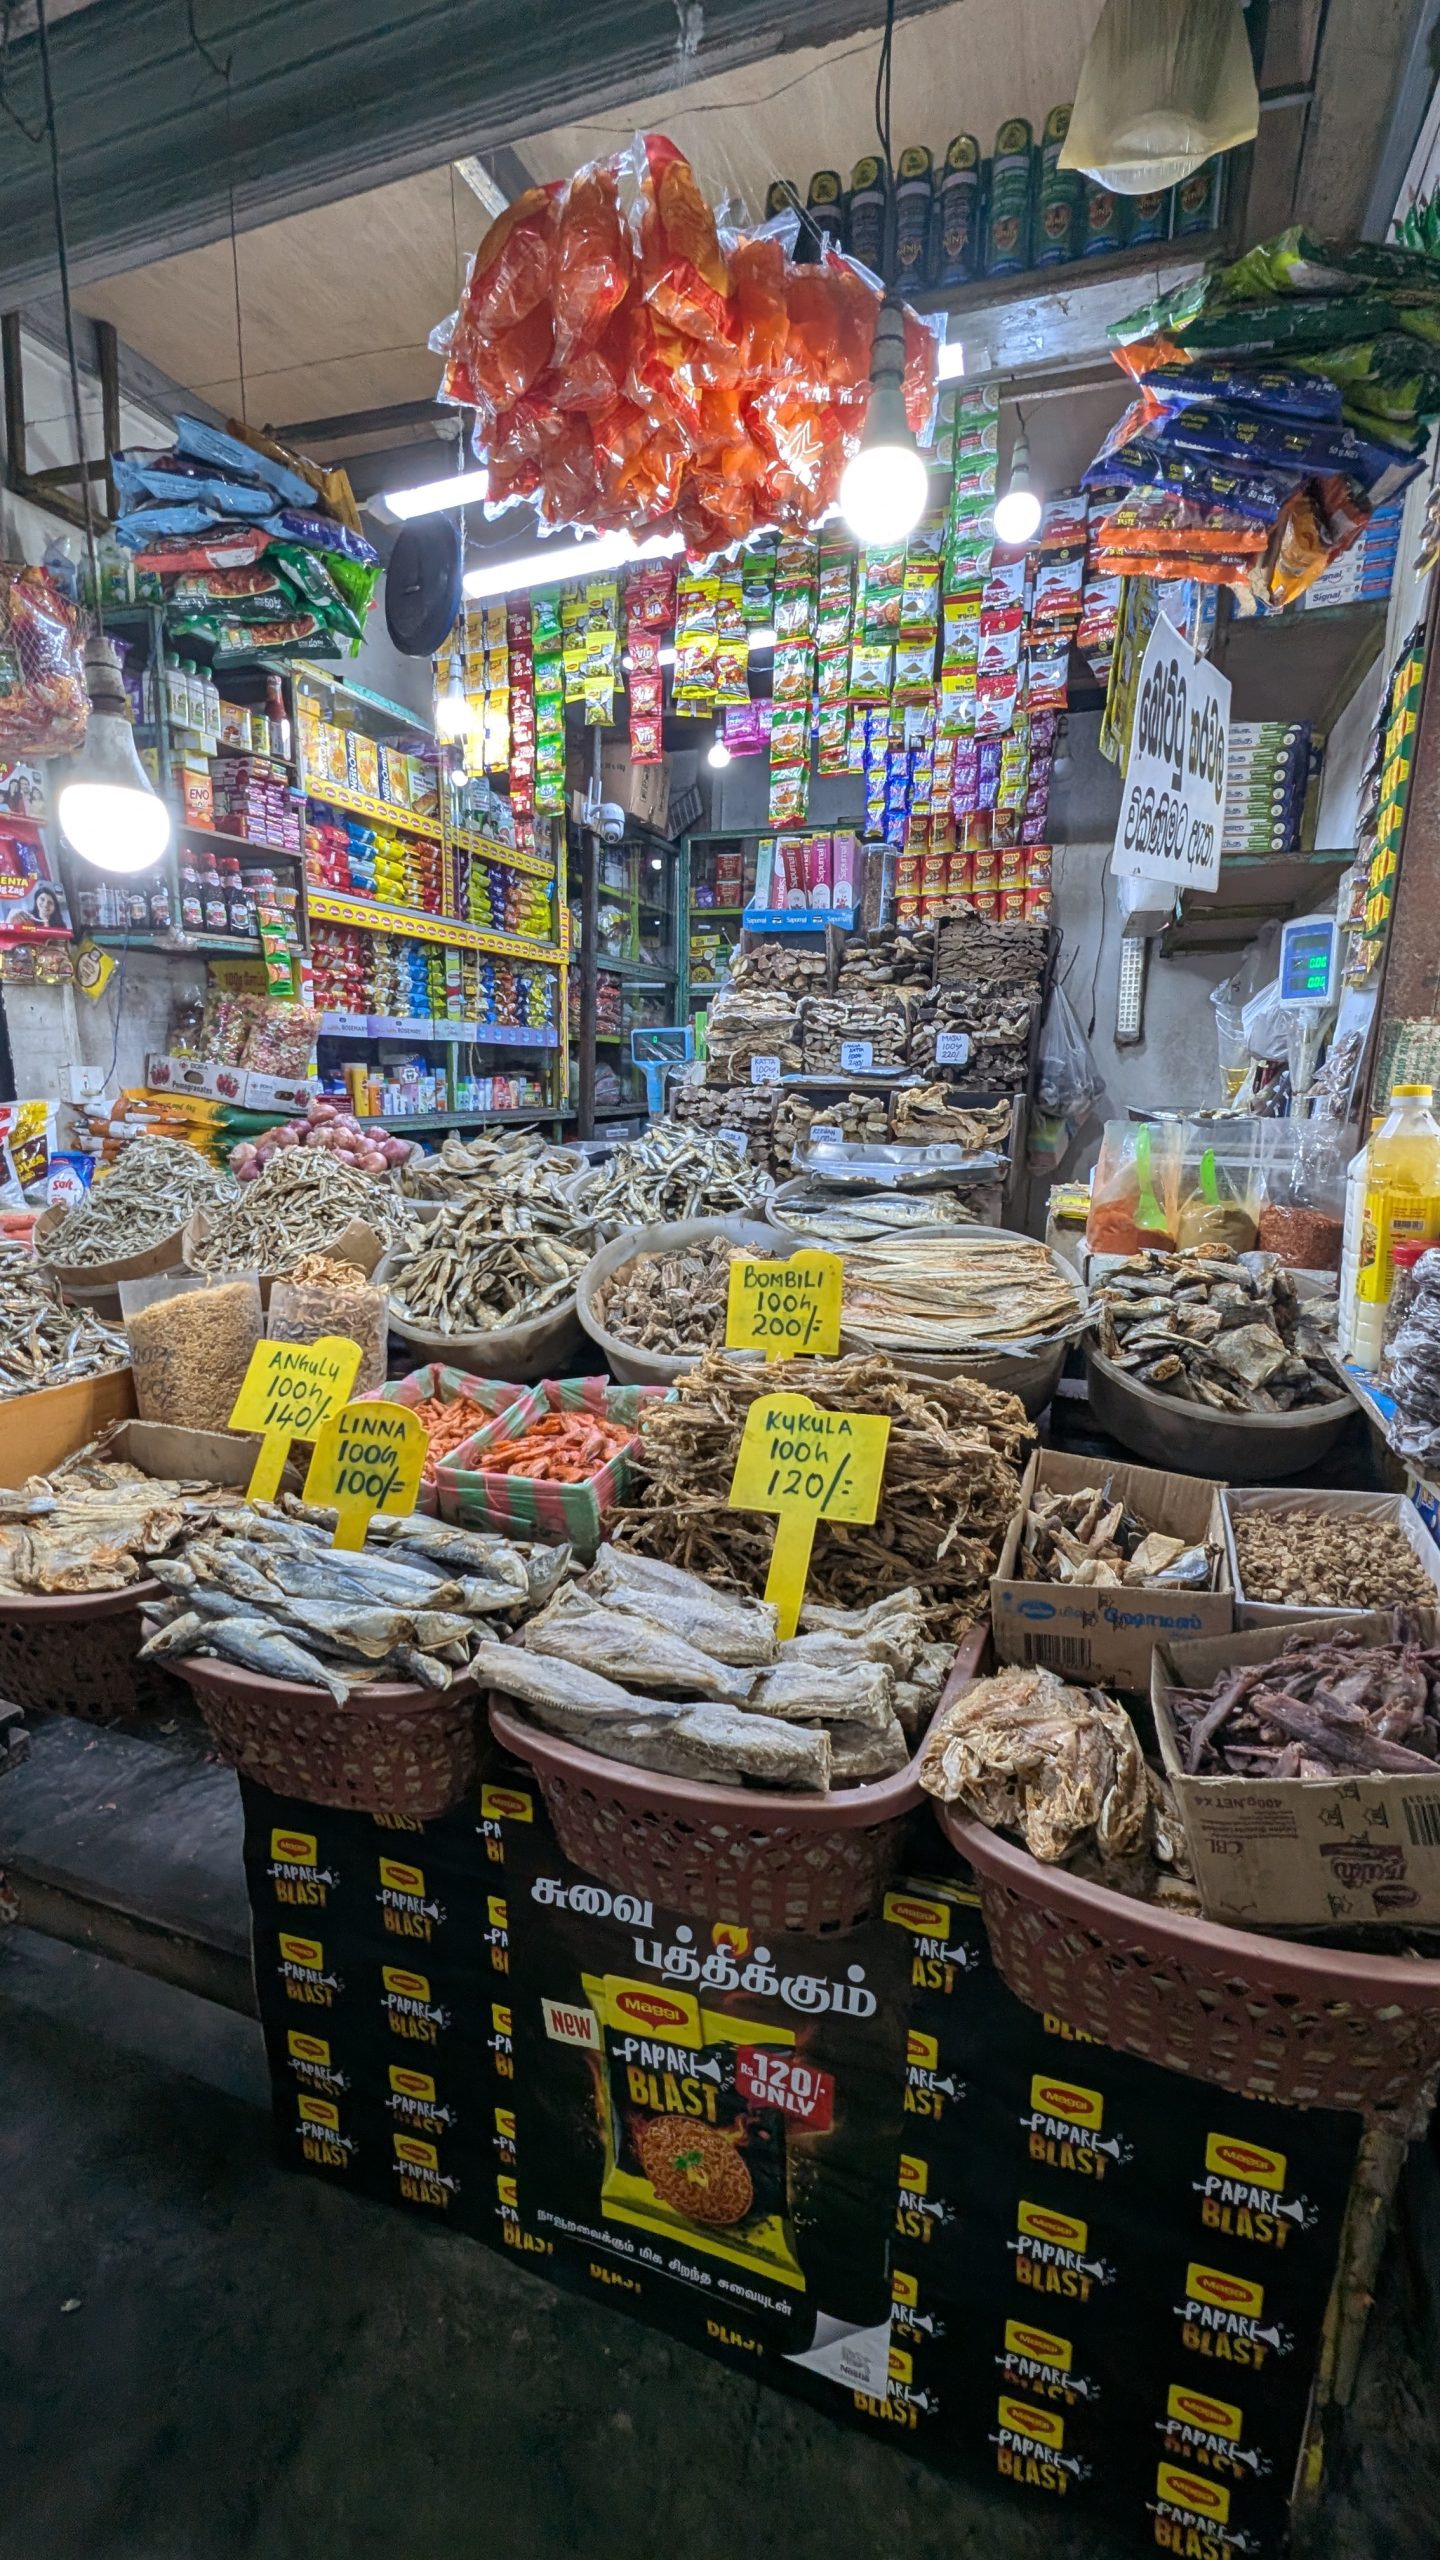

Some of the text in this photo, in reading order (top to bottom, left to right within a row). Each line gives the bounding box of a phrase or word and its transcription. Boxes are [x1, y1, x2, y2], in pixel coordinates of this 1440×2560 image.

[1312, 589, 1342, 603] Signal
[189, 788, 210, 800] ENO
[52, 1179, 74, 1191] Salt
[744, 1265, 824, 1289] BOMBILI
[338, 1414, 407, 1441] LINNA
[275, 1879, 328, 1908] BLAST
[531, 1877, 655, 1928] சுவை
[383, 1907, 433, 1944] BLAST
[633, 1925, 877, 2018] பத்திக்கும்
[911, 1956, 957, 1994] AST
[286, 1977, 333, 2008] BLAST
[388, 2010, 438, 2046] BLAST
[622, 2037, 700, 2079] PAPARE
[626, 2064, 719, 2122] BLAST
[750, 2079, 815, 2116] ONLY
[904, 2086, 945, 2121] AST
[1030, 2112, 1101, 2152] PAPARE
[302, 2136, 349, 2169] BLAST
[1028, 2131, 1109, 2181] BLAST
[400, 2175, 449, 2211] BLAST
[1204, 2175, 1283, 2218] PAPARE
[895, 2206, 935, 2243] AST
[1201, 2197, 1293, 2250] BLAST
[1017, 2235, 1086, 2274] PAPARE
[1015, 2255, 1094, 2303] BLAST
[1184, 2301, 1261, 2342] PAPARE
[1182, 2322, 1270, 2372] BLAST
[996, 2446, 1071, 2496] BLAST
[1154, 2515, 1233, 2560] BLAST
